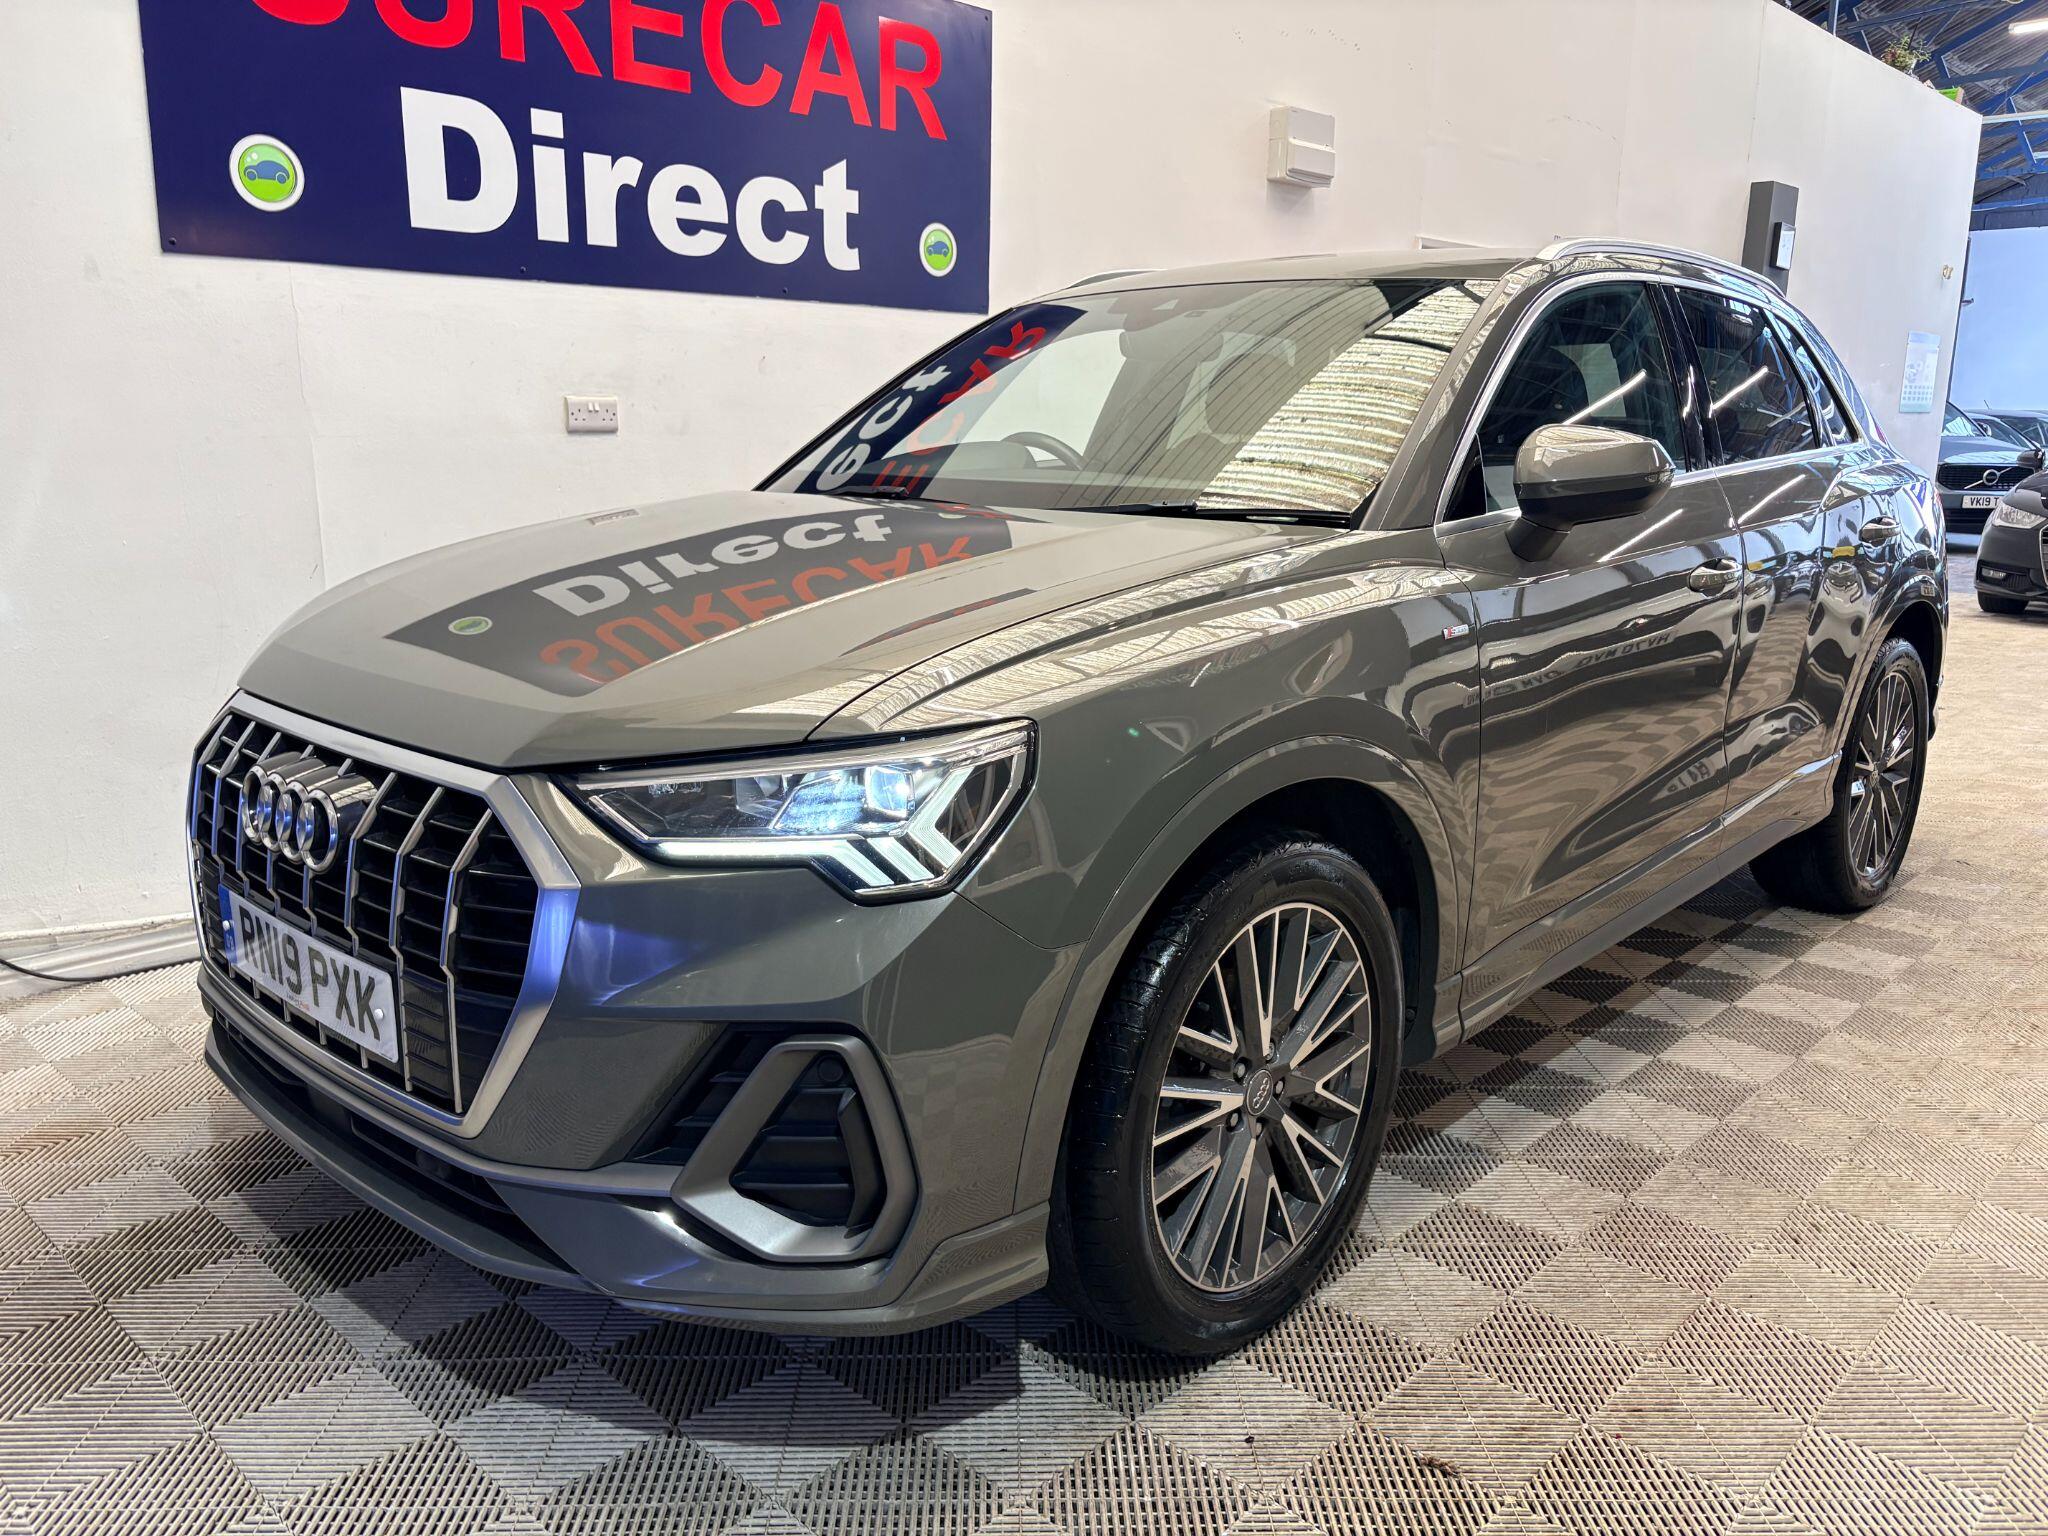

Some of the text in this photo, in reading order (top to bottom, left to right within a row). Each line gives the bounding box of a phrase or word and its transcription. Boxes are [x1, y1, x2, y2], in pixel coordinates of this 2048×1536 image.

[400, 86, 861, 271] Direct
[1970, 497, 1991, 506] VK19
[239, 905, 380, 1041] RN19 PXK
